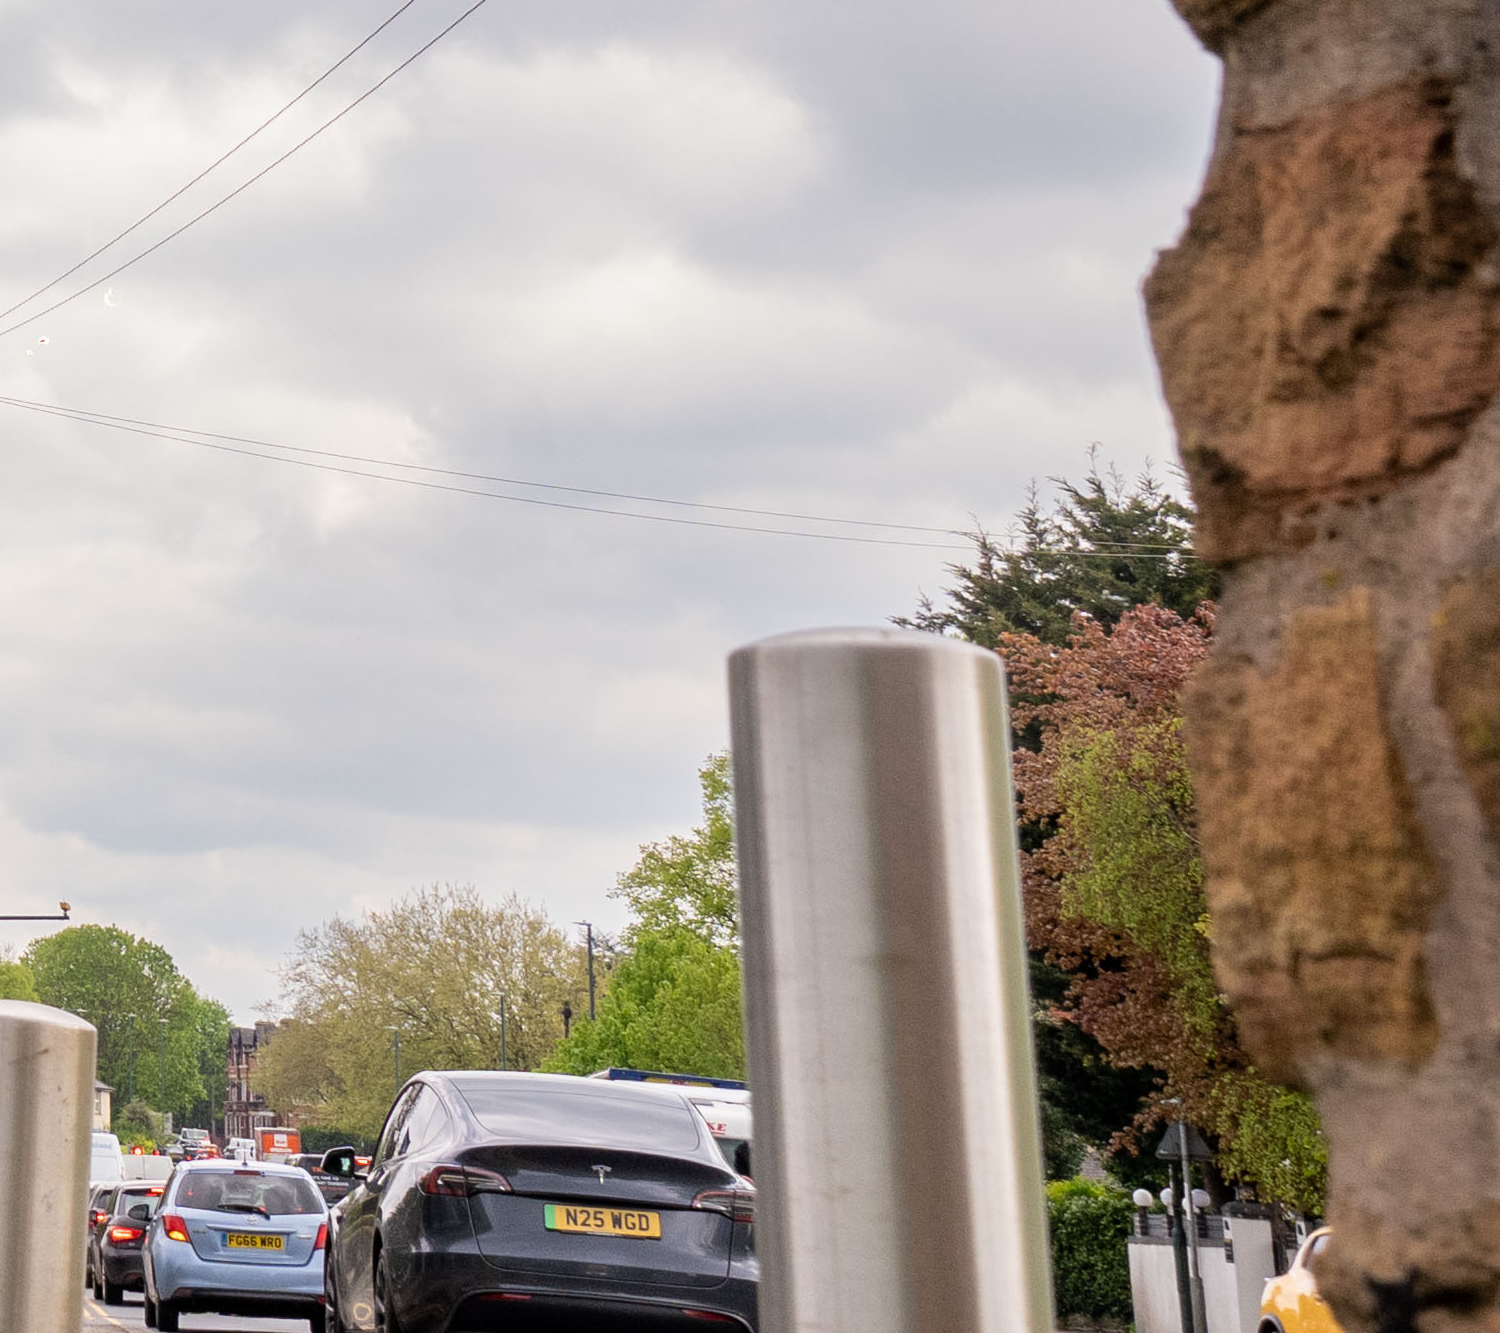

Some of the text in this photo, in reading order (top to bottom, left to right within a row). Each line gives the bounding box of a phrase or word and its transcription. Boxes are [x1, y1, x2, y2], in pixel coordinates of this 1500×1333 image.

[565, 1207, 650, 1232] N25 WGD
[228, 1234, 282, 1249] FG66 WRO
